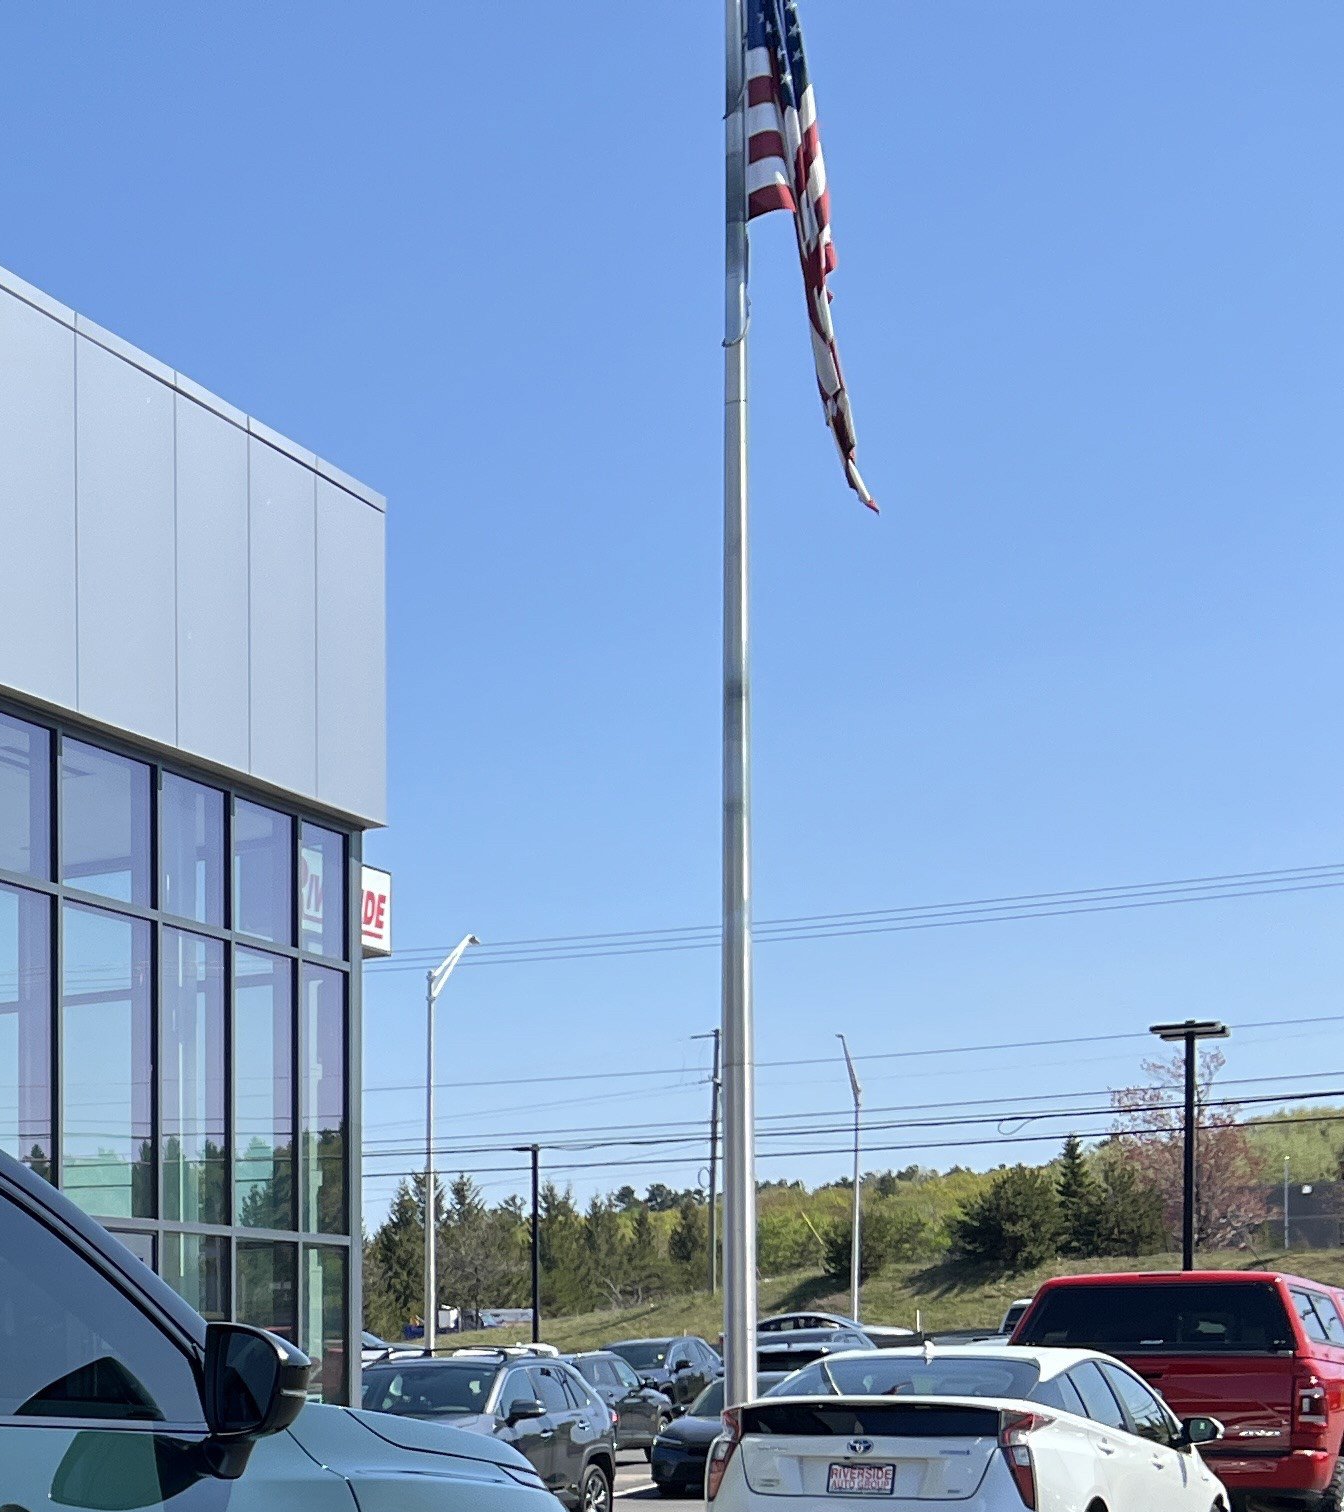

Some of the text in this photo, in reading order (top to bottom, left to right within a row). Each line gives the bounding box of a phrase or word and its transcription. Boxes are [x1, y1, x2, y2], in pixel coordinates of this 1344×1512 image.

[361, 890, 387, 929] DE
[830, 1468, 892, 1480] RIVERSIDE
[832, 1479, 890, 1490] AUTO GROUP
